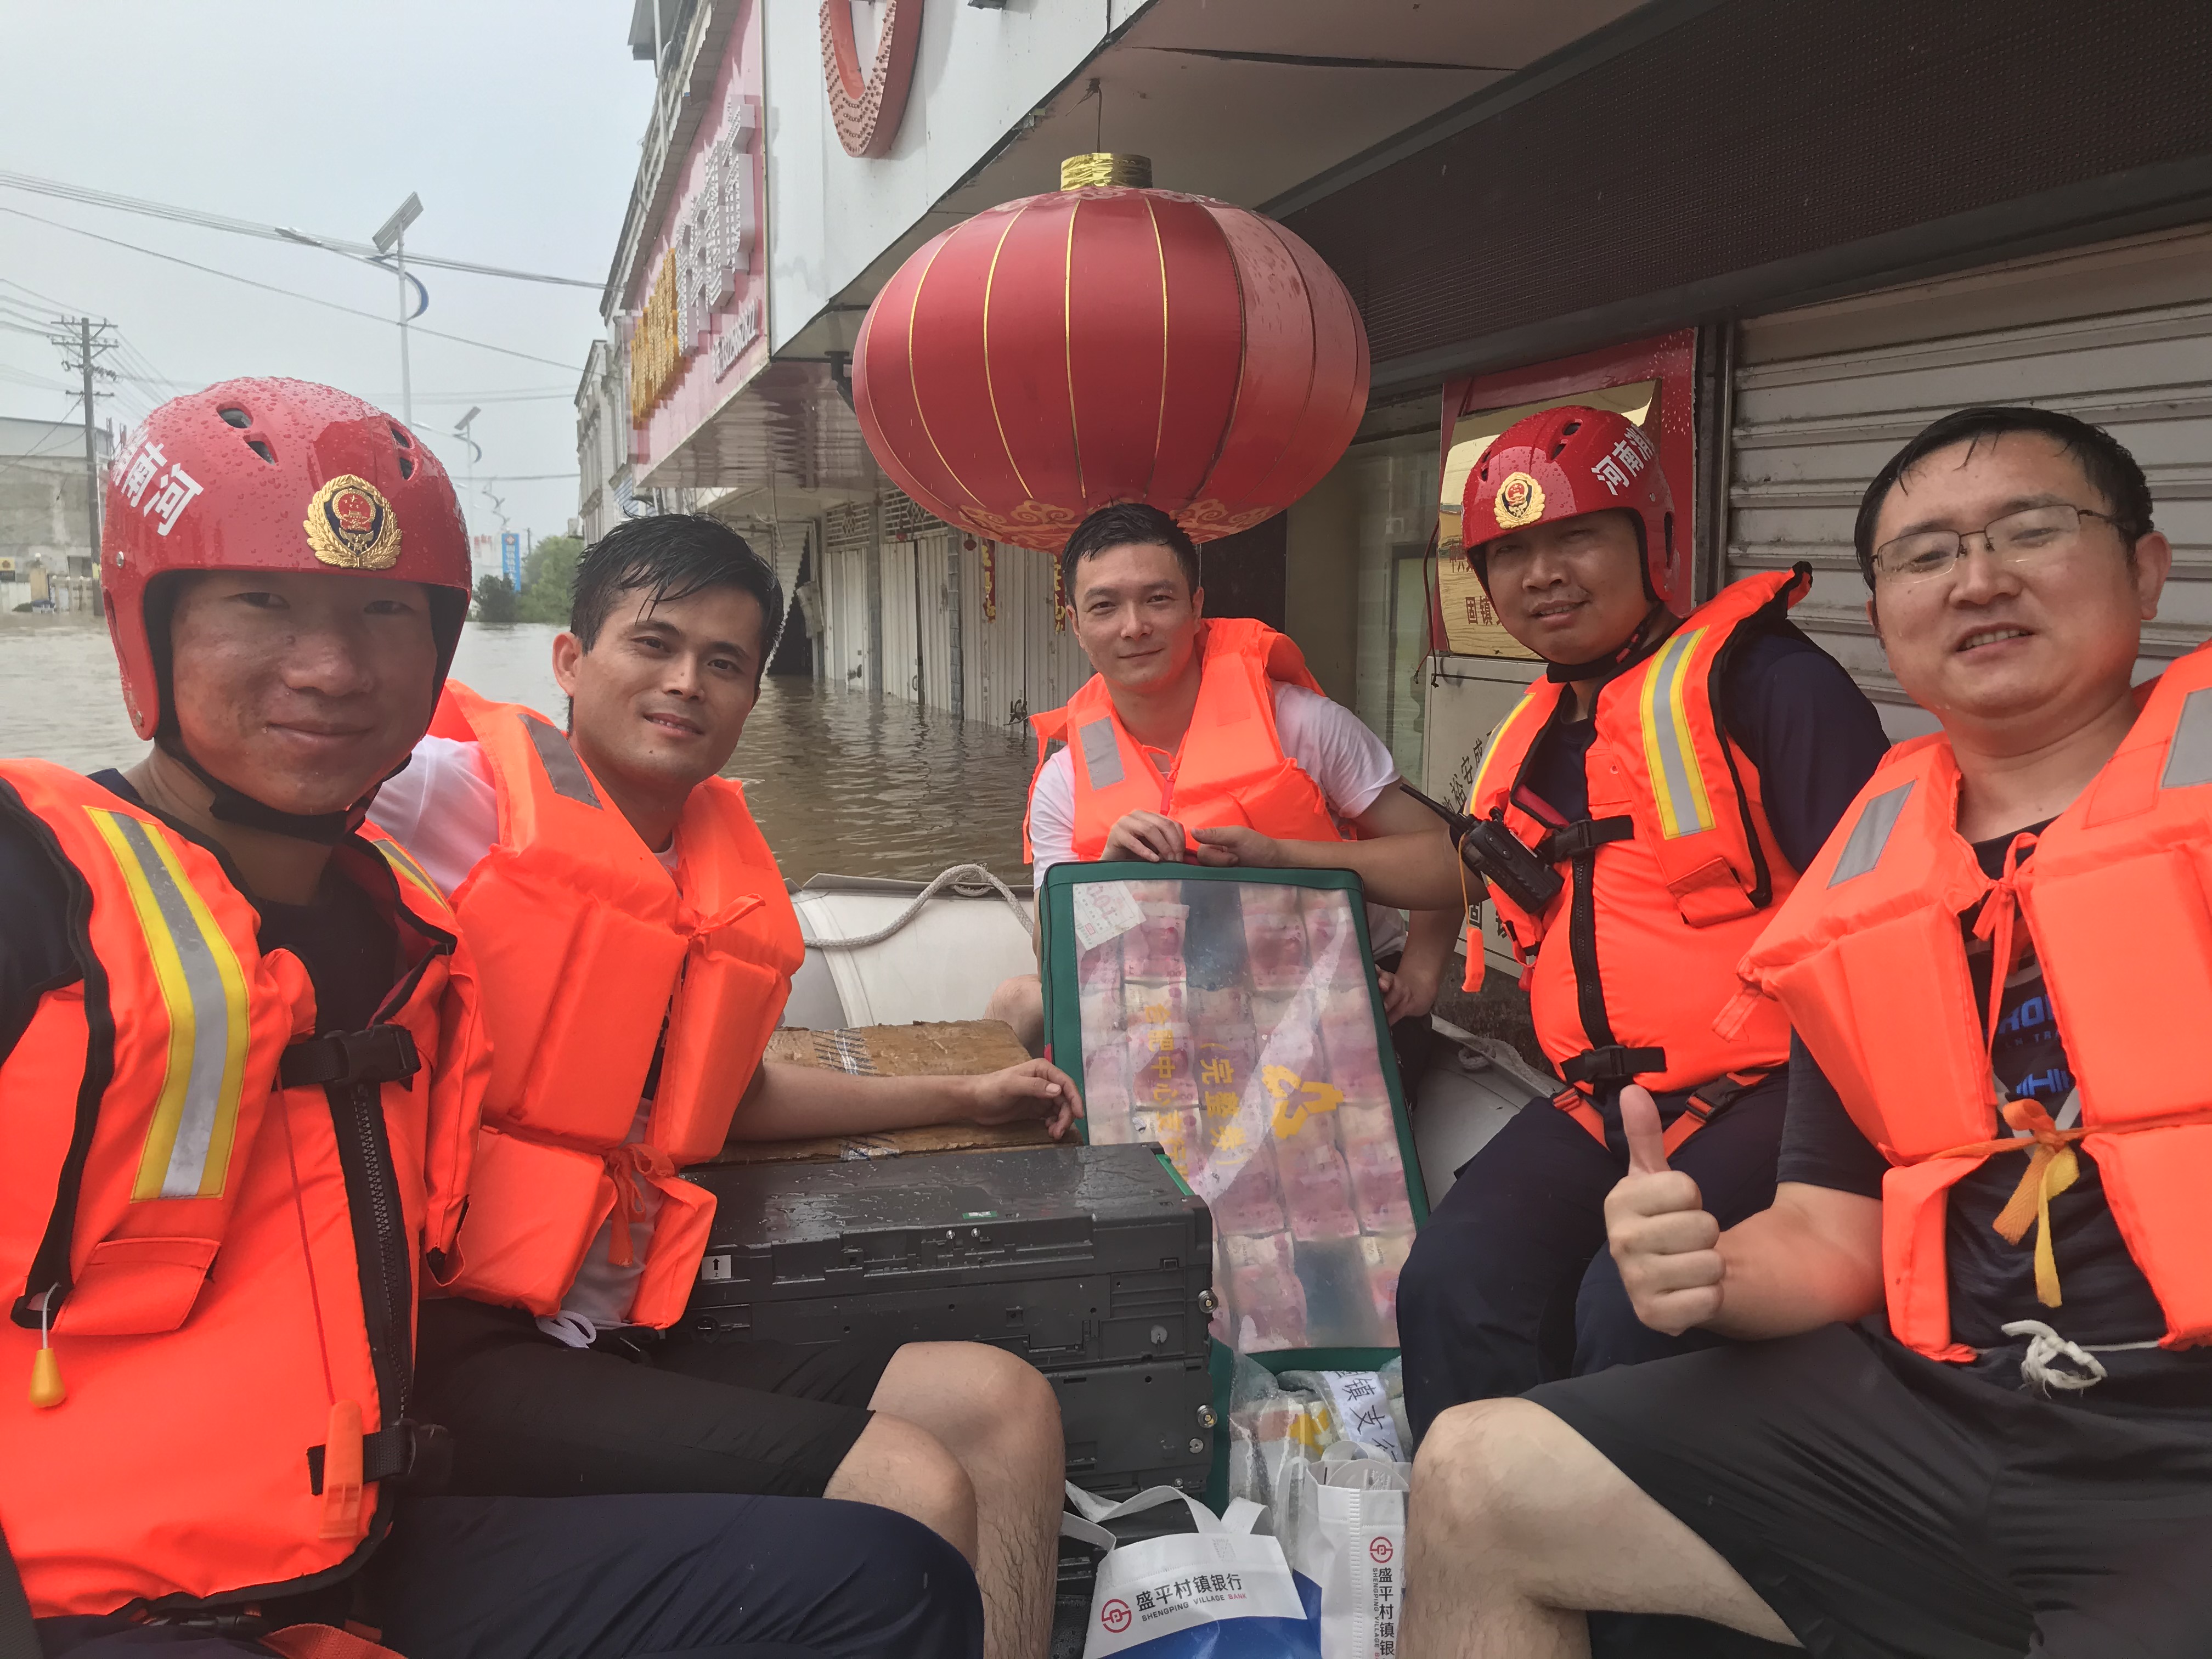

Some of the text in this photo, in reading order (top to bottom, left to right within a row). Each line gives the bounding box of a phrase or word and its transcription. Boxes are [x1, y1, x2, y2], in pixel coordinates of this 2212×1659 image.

[1591, 424, 1655, 496] 河南消
[1465, 595, 1502, 626] 固镇
[1336, 1371, 1398, 1463] 镇支行
[1136, 1573, 1242, 1612] 盛平村镇银行
[1141, 1601, 1189, 1622] SHENGPING
[1193, 1595, 1225, 1605] VILLAGE
[1378, 1567, 1395, 1659] 盛平村镇银
